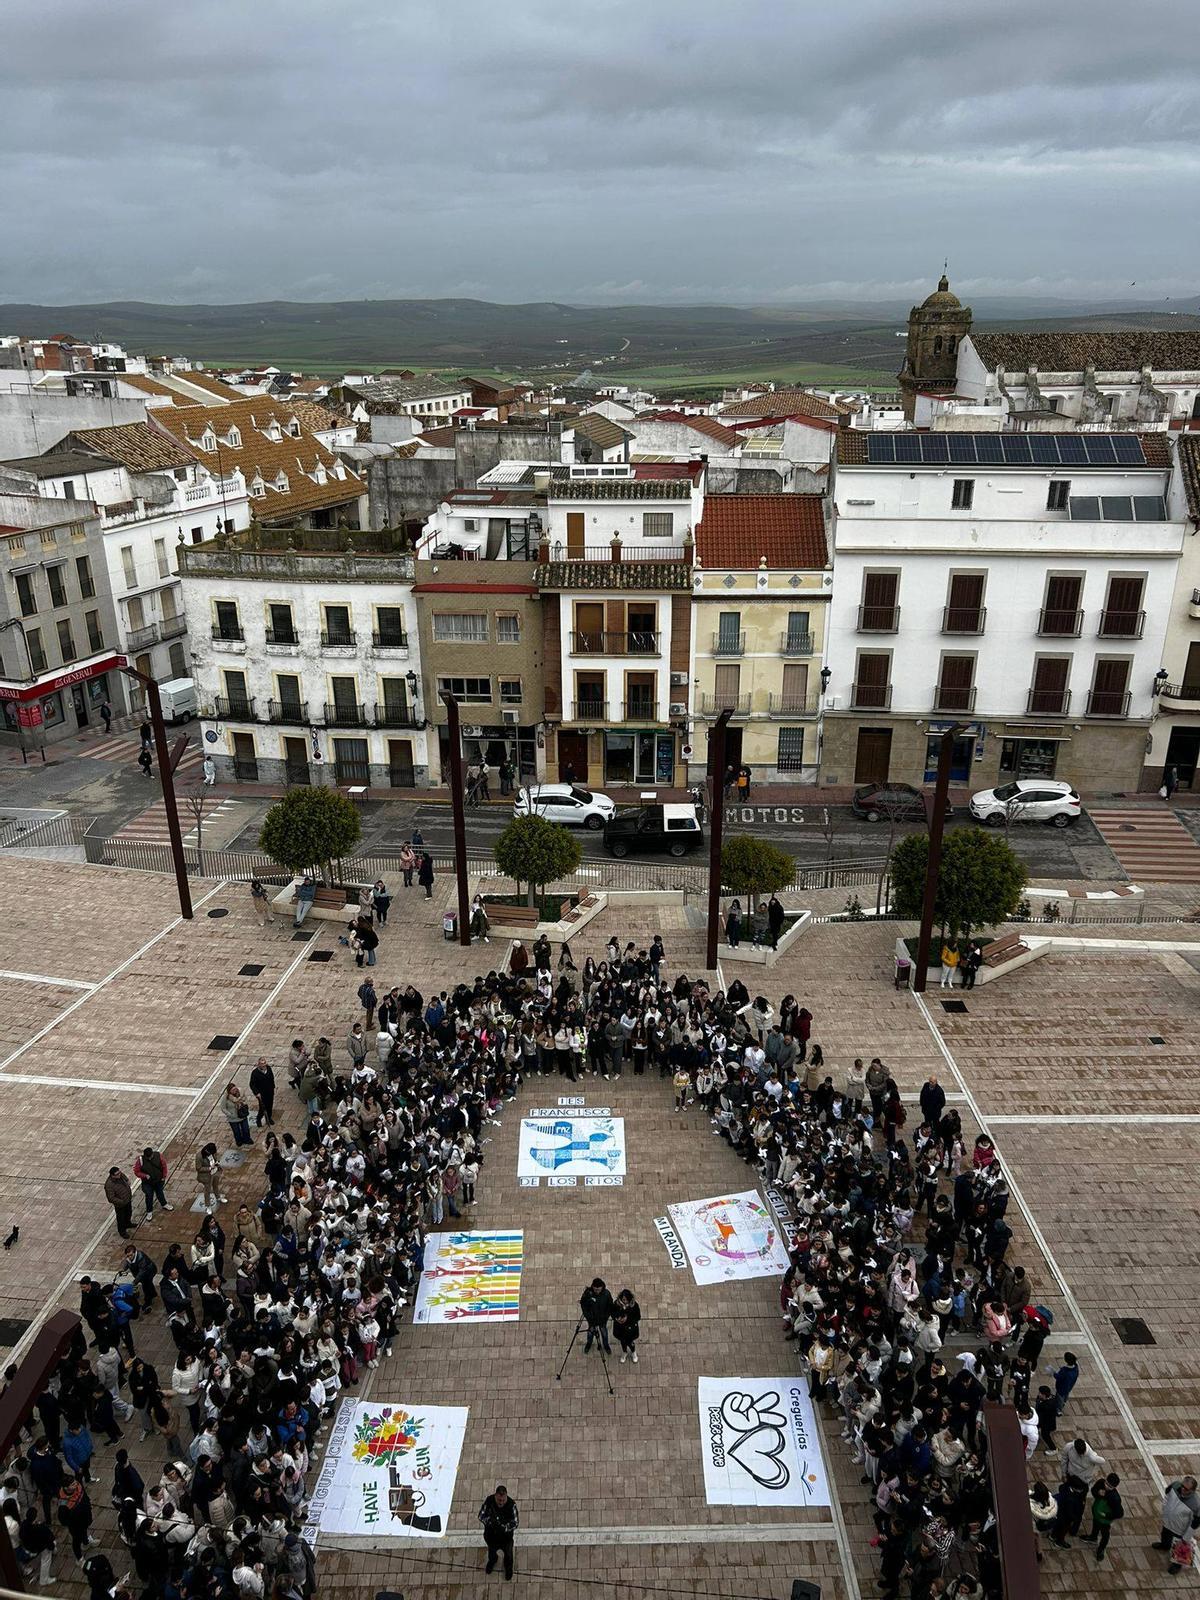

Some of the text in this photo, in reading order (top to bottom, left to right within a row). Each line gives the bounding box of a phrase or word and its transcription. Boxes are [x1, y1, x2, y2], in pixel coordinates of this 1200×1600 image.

[63, 667, 93, 685] GENERALI
[725, 808, 805, 823] MOTOS
[560, 1097, 585, 1105] IES
[531, 1109, 610, 1117] FRANCISCO
[520, 1177, 538, 1186] DE
[549, 1177, 576, 1186] LOS
[767, 1190, 788, 1217] CEIP
[656, 1217, 685, 1268] MIRANDA
[329, 1397, 357, 1456] CRESPO
[790, 1387, 808, 1450] Greguerías
[363, 1481, 380, 1524] HAVE
